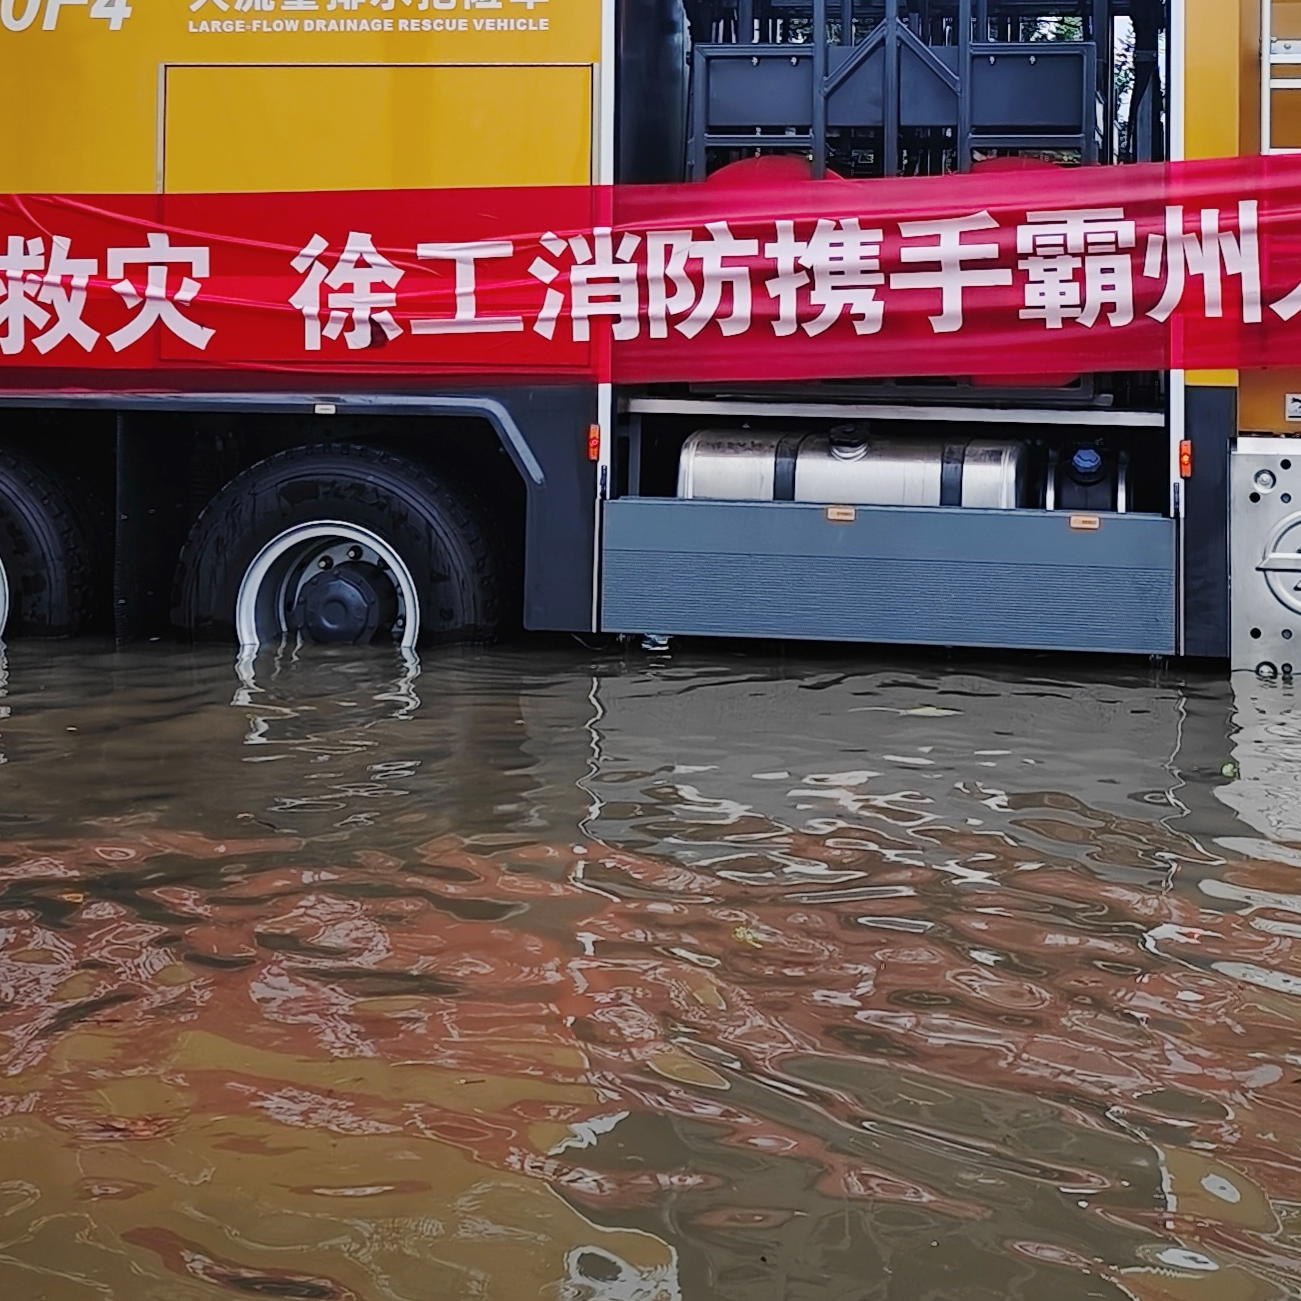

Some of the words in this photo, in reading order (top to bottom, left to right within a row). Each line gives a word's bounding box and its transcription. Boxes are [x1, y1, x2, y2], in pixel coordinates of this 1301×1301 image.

[188, 18, 300, 33] LARGE-FLOW
[303, 18, 394, 32] DRAINAGE
[398, 18, 469, 32] RESCUE
[473, 18, 550, 31] VEHICLE
